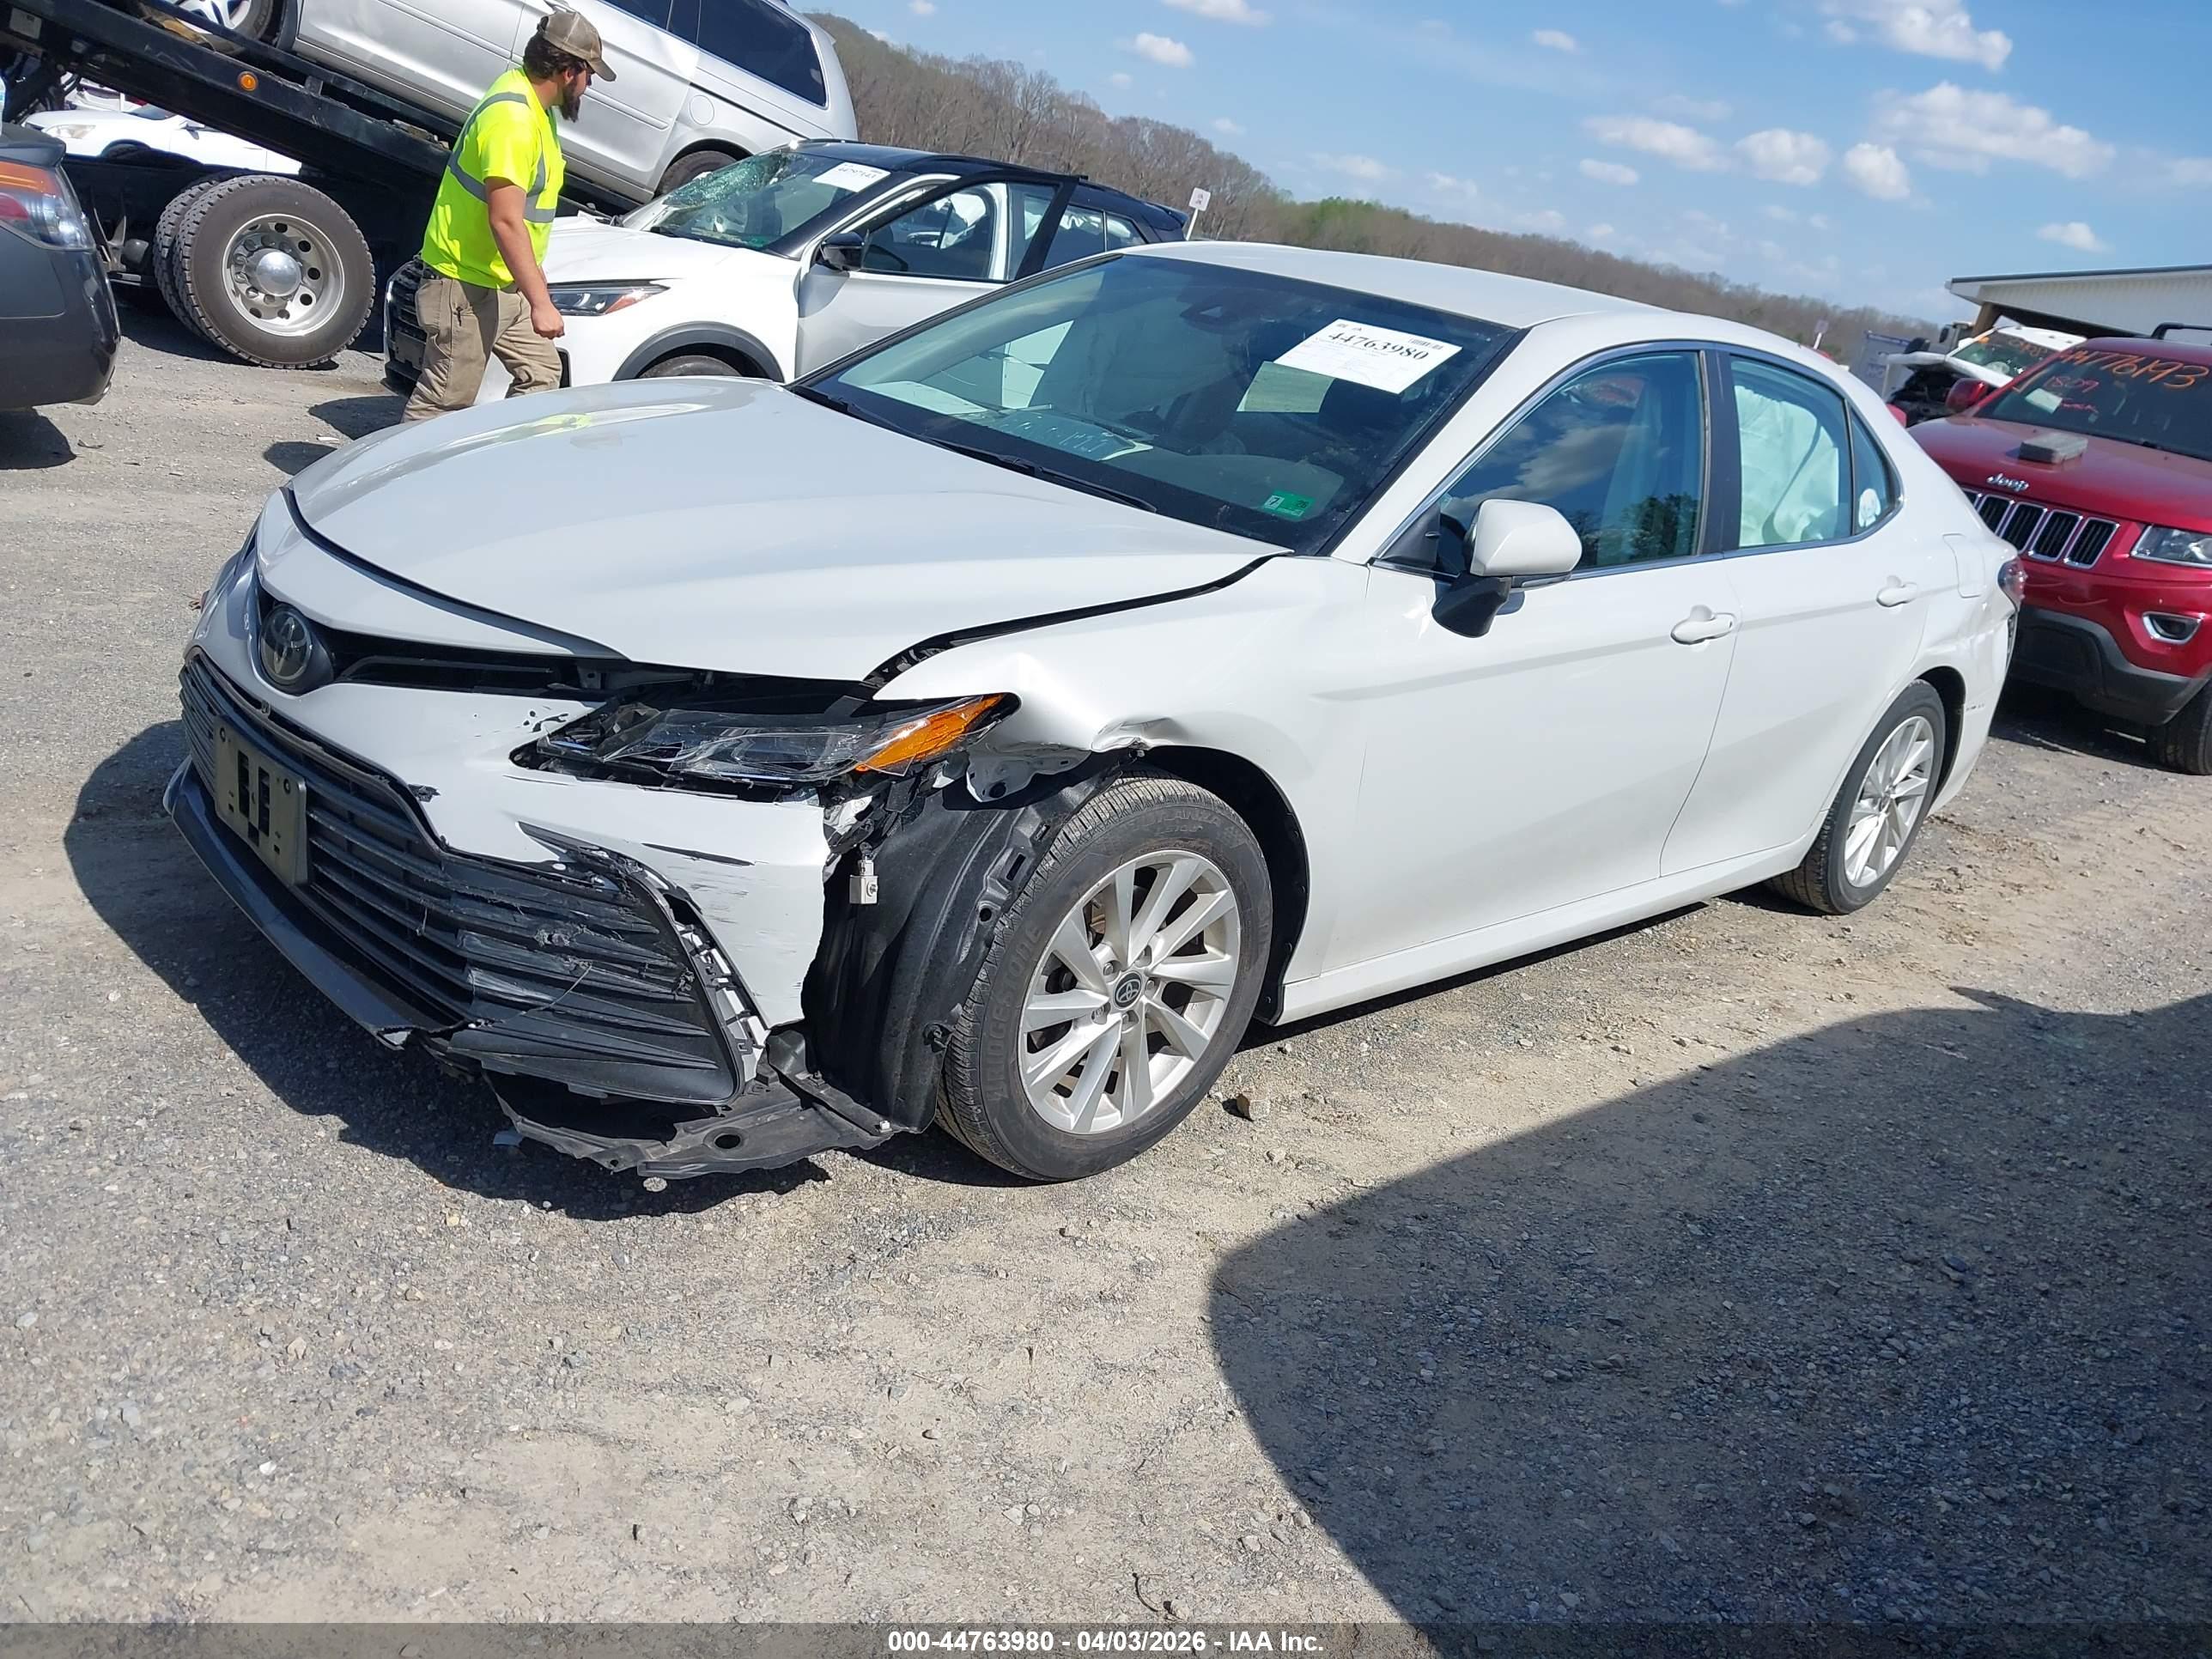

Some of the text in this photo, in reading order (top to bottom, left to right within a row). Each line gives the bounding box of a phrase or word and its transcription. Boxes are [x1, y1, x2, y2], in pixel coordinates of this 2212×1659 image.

[1328, 331, 1430, 361] 44763980
[1986, 472, 2030, 492] Jeep
[1269, 497, 1279, 506] 7
